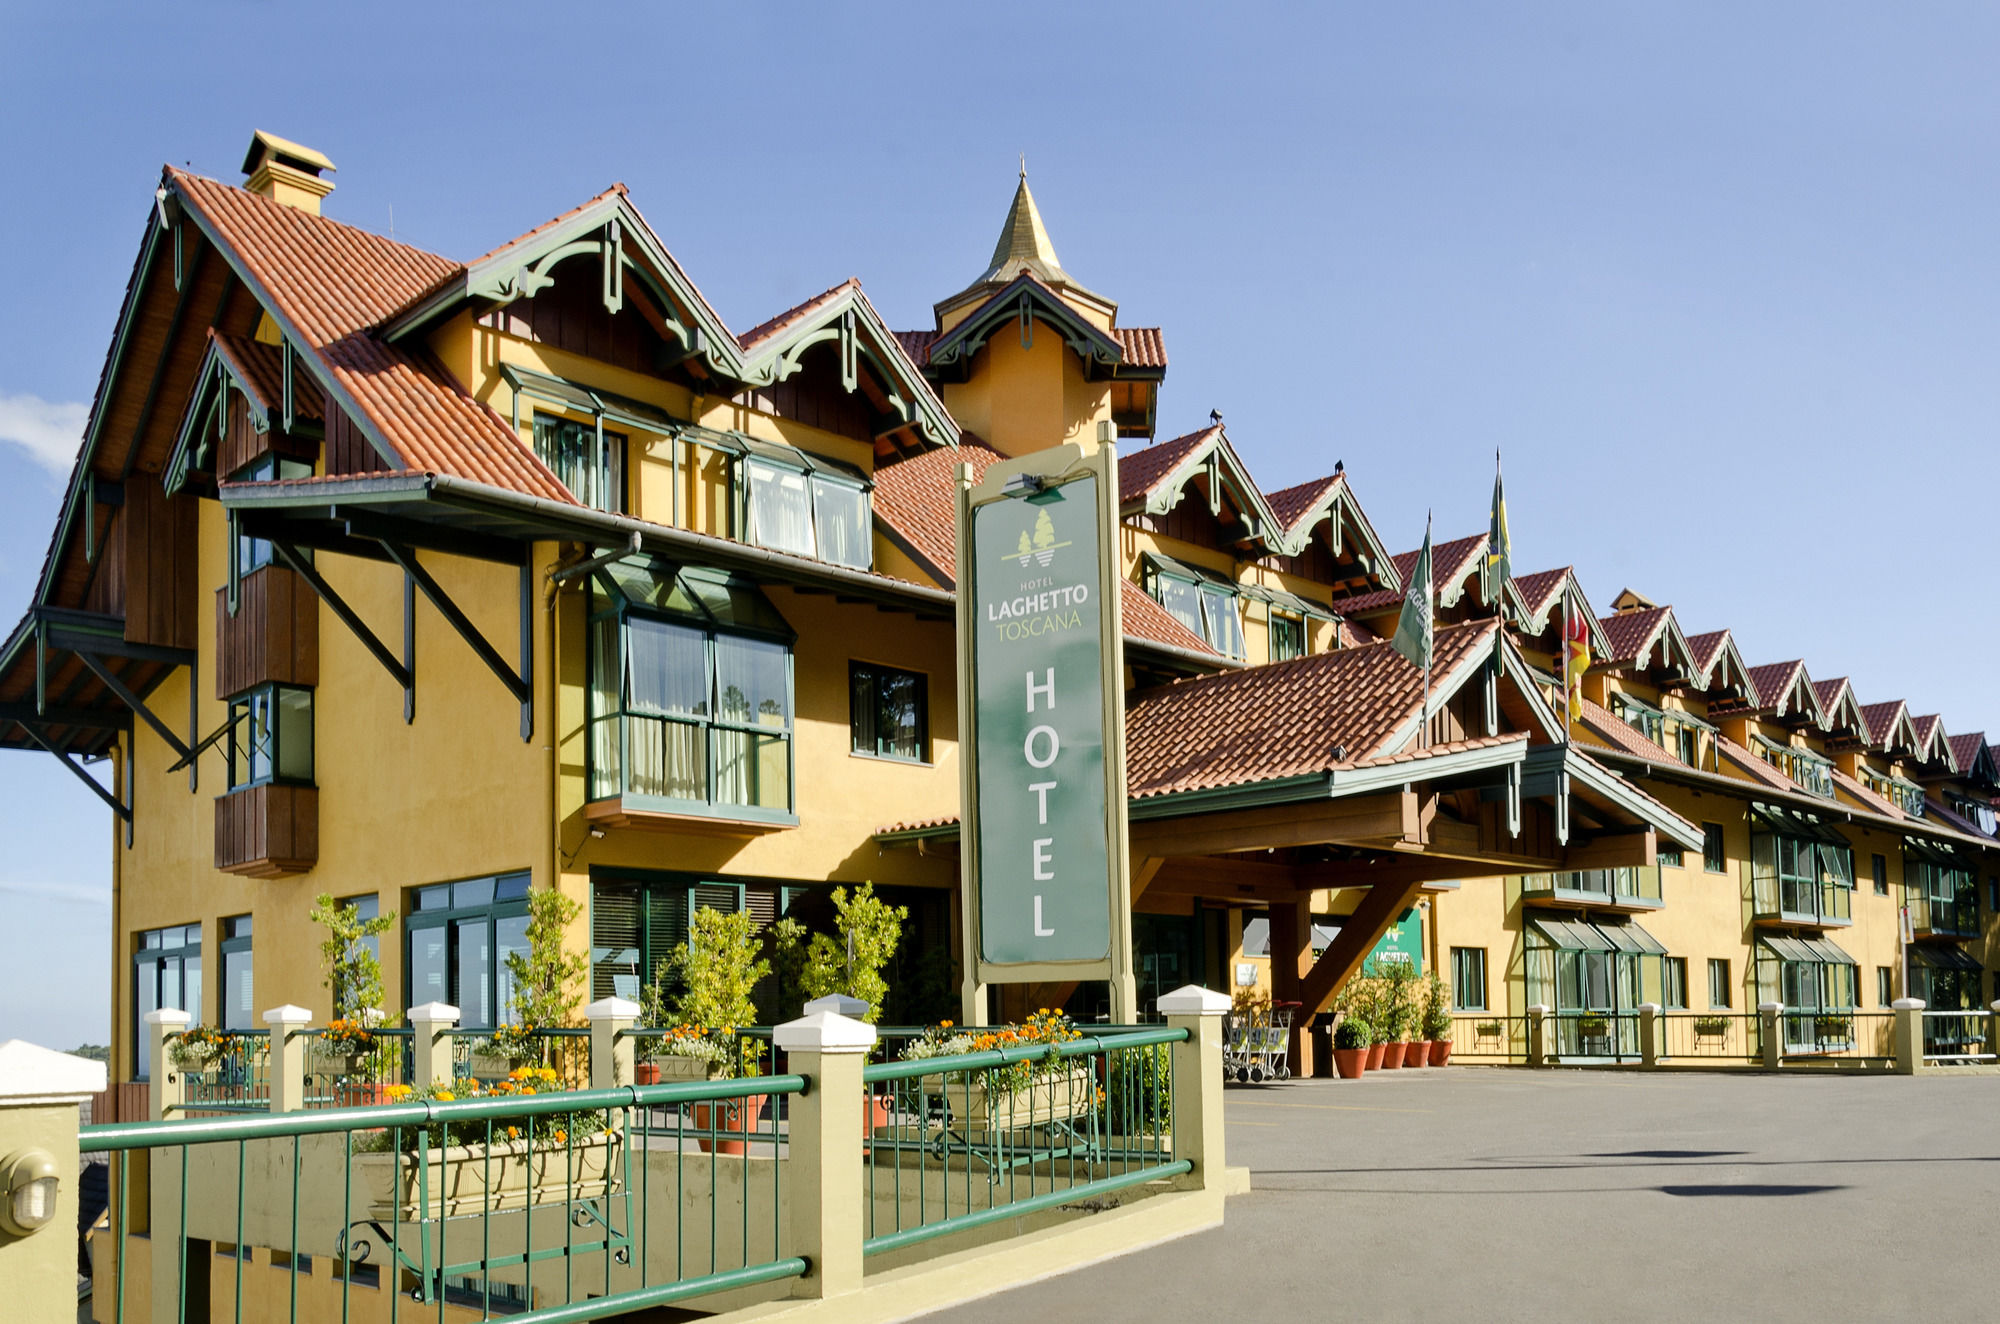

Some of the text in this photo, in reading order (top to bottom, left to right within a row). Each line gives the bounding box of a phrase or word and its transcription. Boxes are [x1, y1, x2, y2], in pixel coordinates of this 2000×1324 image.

[1020, 577, 1054, 591] HOTEL
[988, 584, 1088, 621] LAGHETTO
[996, 608, 1082, 641] TOSCANA
[1024, 667, 1060, 937] HOTEL
